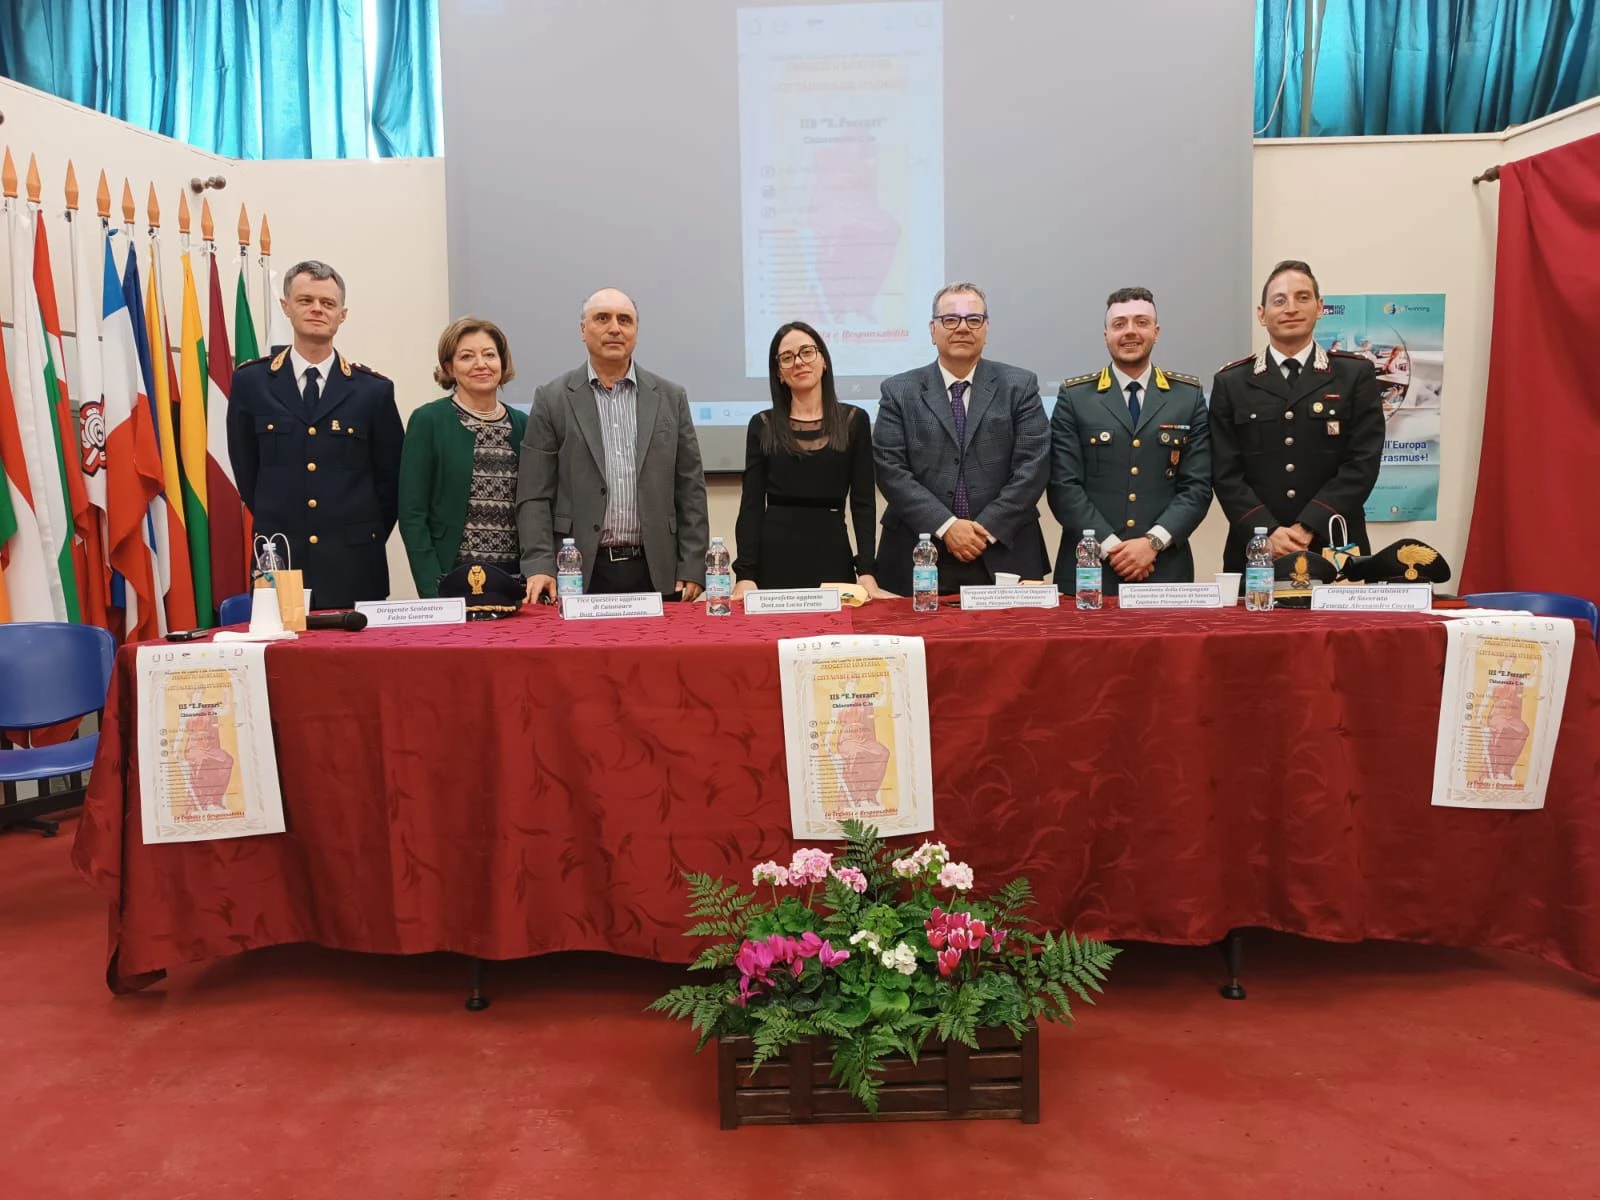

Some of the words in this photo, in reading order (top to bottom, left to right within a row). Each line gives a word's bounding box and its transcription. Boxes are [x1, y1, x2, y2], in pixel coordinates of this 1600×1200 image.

[1384, 440, 1427, 451] ll'Europa
[1382, 453, 1429, 462] rasmus+!
[376, 606, 409, 614] Dirigente
[829, 693, 840, 701] IIS
